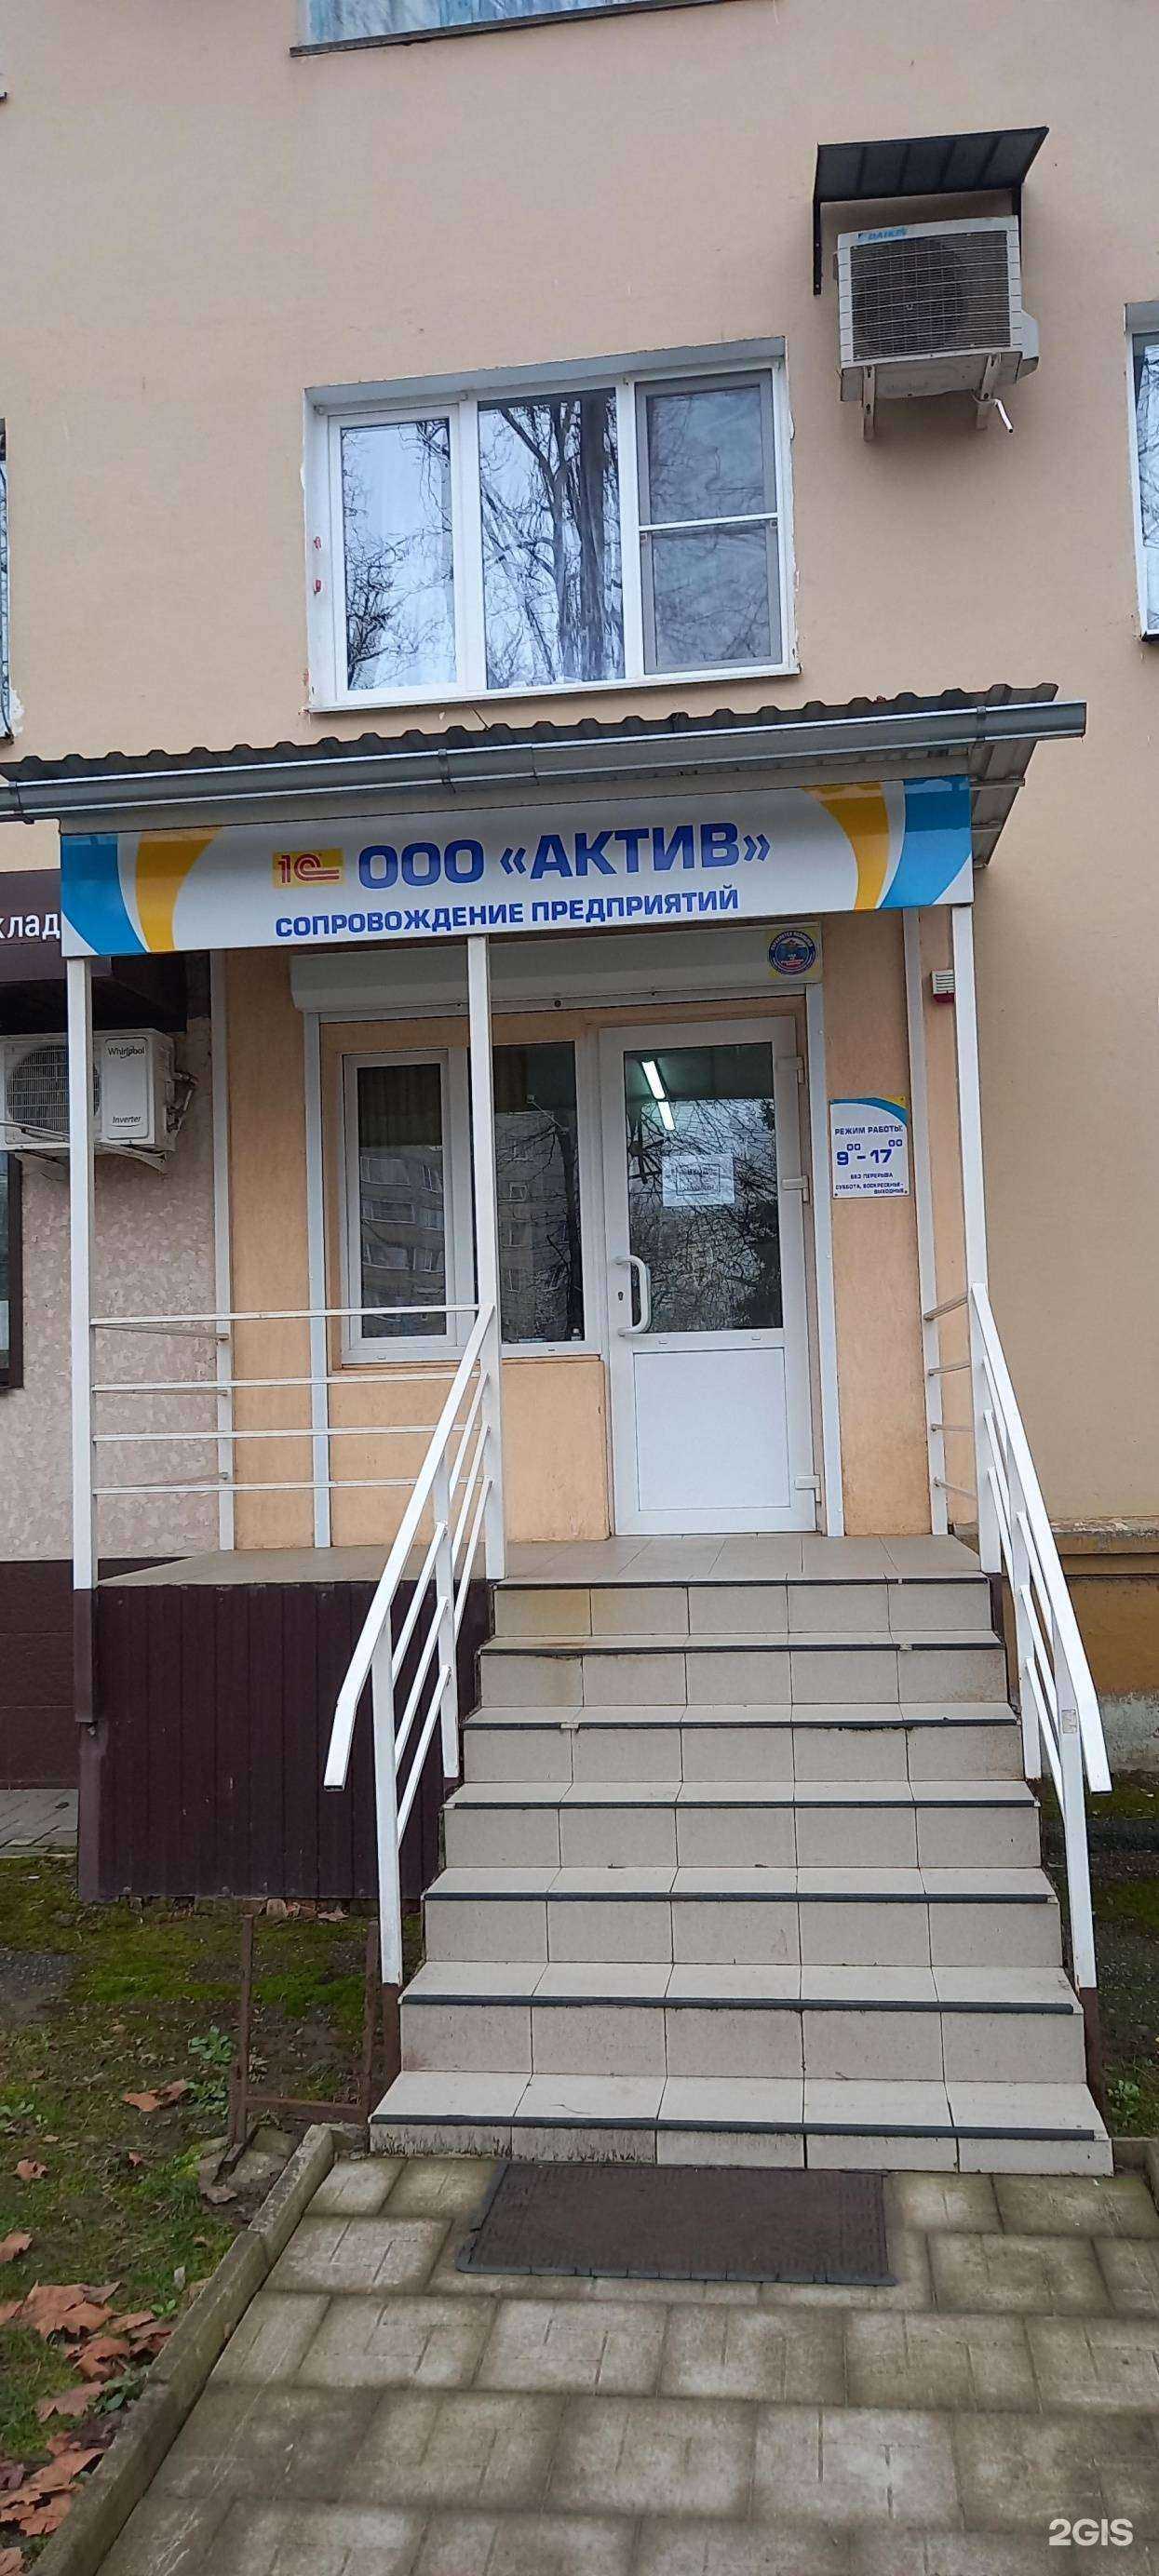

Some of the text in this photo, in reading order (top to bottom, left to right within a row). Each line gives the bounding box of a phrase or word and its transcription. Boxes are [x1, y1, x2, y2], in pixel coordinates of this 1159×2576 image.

[358, 839, 484, 889] ООО
[499, 822, 771, 879] «АКТИВ»
[276, 883, 739, 937] СОПРОВОЖДЕНИЕ ПРЕДПРИЯТИЙ
[108, 1046, 145, 1059] Whirlpool
[112, 1116, 142, 1124] Inverter
